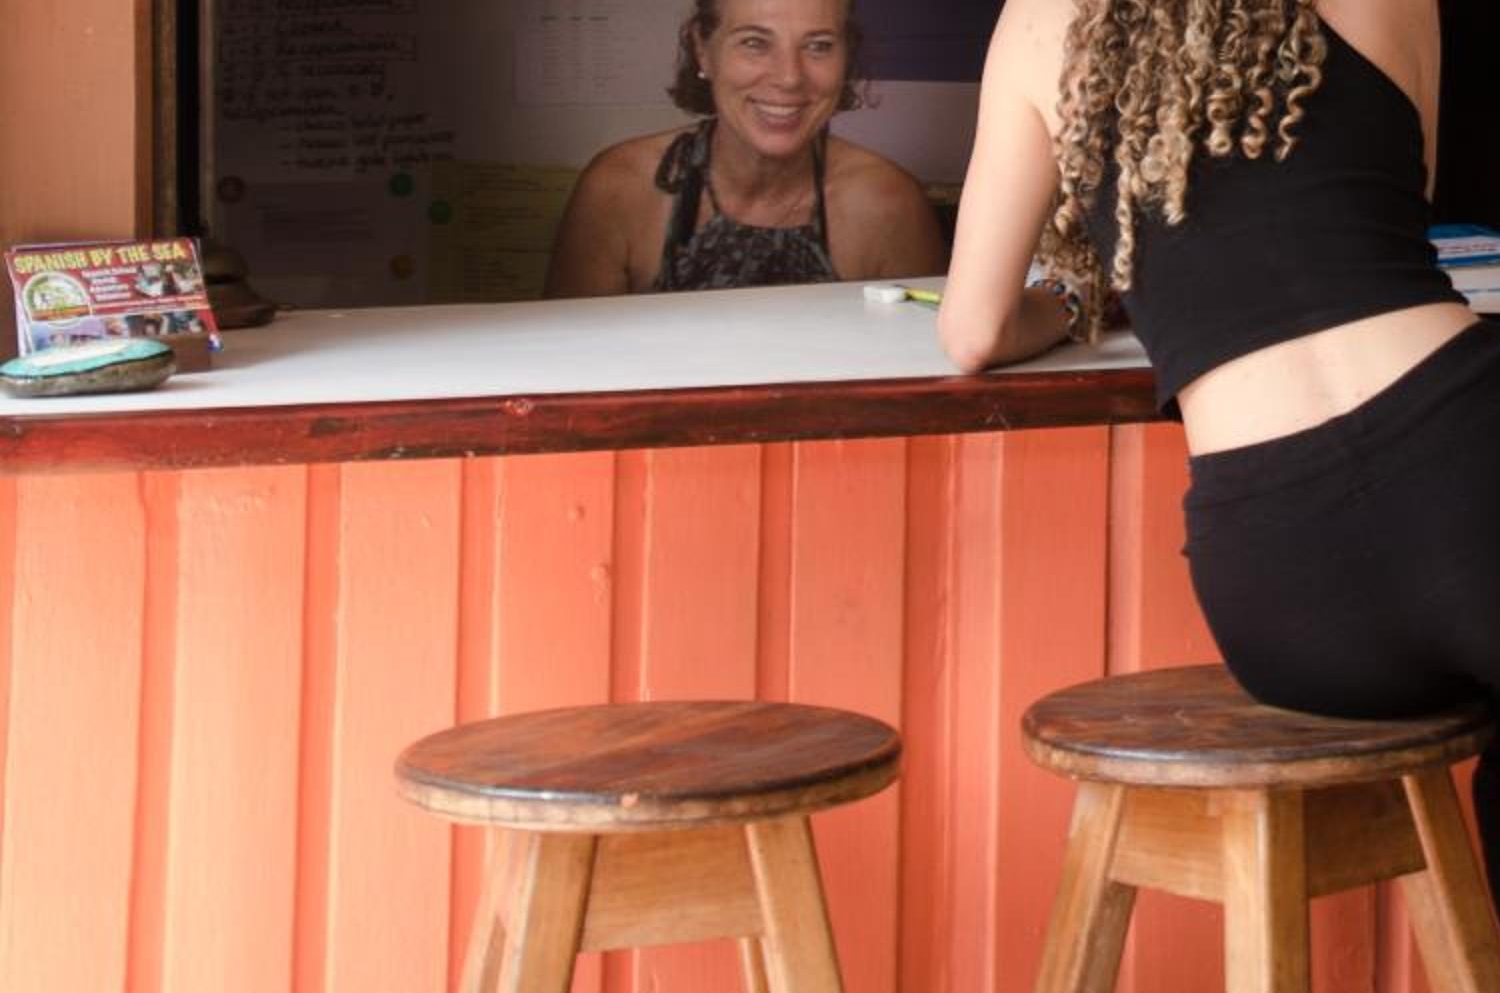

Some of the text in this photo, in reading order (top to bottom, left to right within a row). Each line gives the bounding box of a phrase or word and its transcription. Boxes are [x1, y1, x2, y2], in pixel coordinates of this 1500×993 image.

[14, 240, 188, 274] SPANISH BY THE SEA
